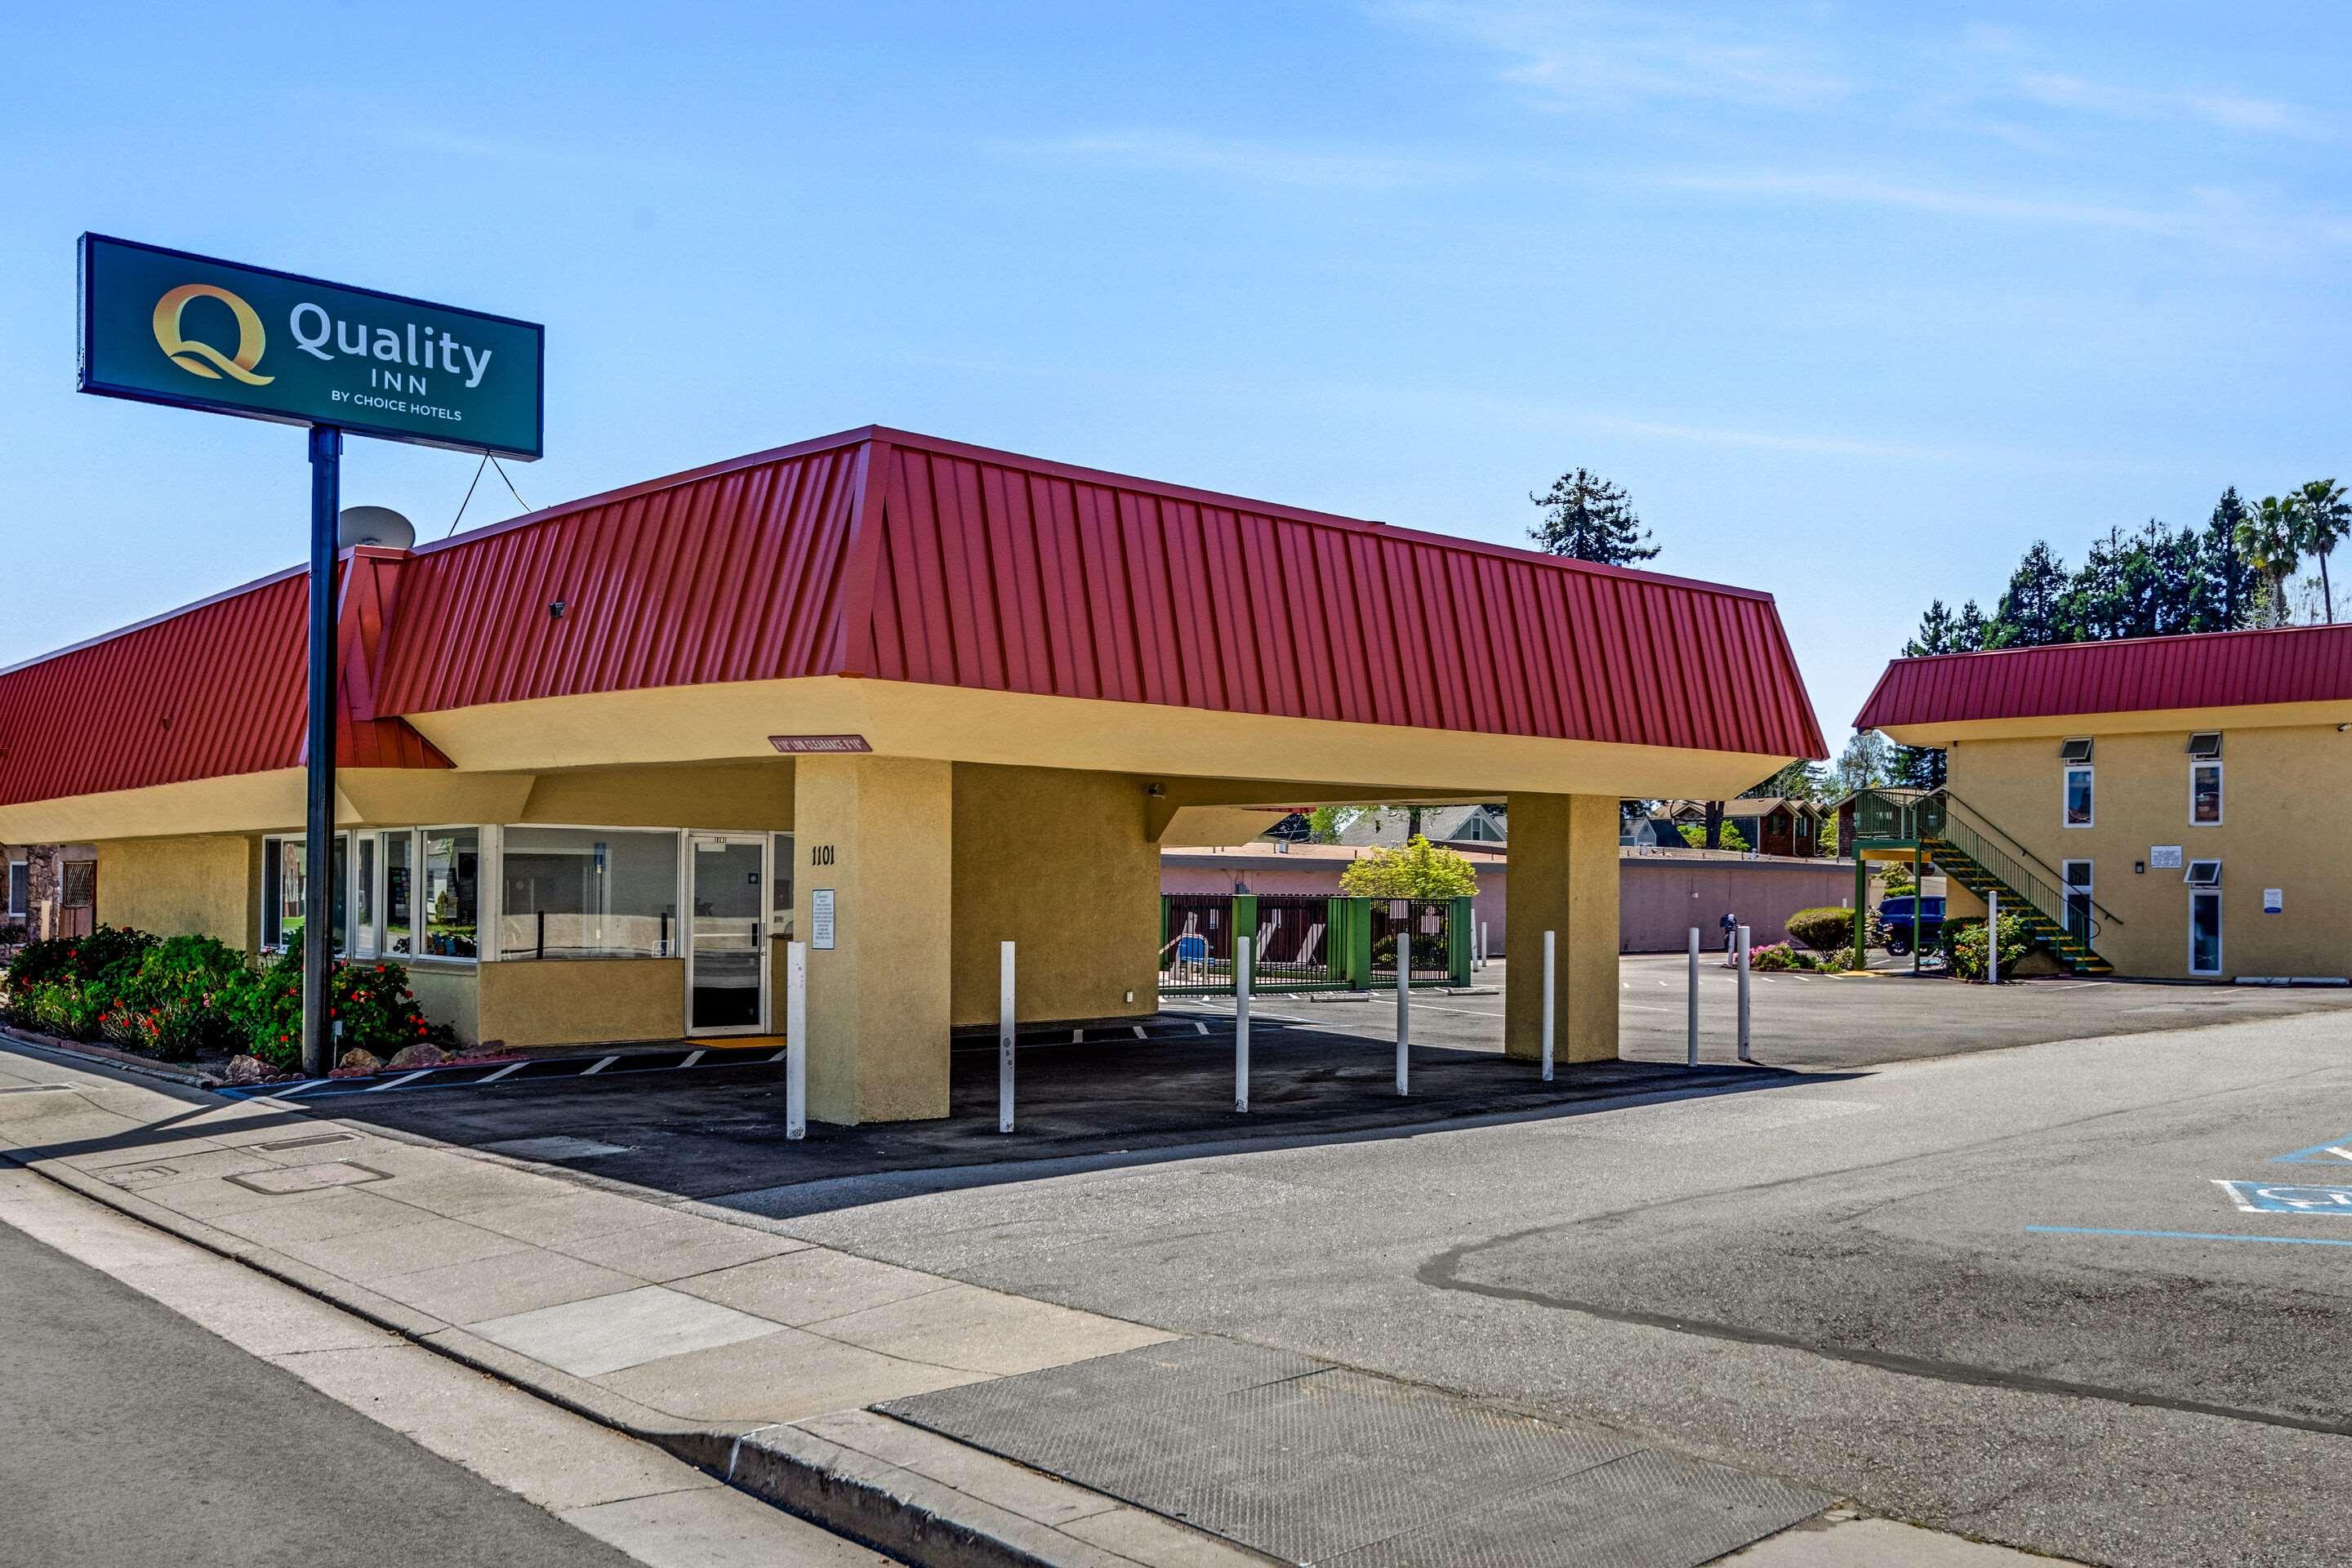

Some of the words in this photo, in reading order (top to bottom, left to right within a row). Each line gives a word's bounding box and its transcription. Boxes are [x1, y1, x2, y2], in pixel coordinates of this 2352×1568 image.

[153, 283, 274, 385] Q
[290, 302, 492, 388] Quality
[372, 368, 426, 396] INN
[332, 390, 350, 402] BY
[354, 394, 407, 412] CHOICE
[411, 403, 462, 421] HOTELS
[812, 844, 835, 866] 1101
